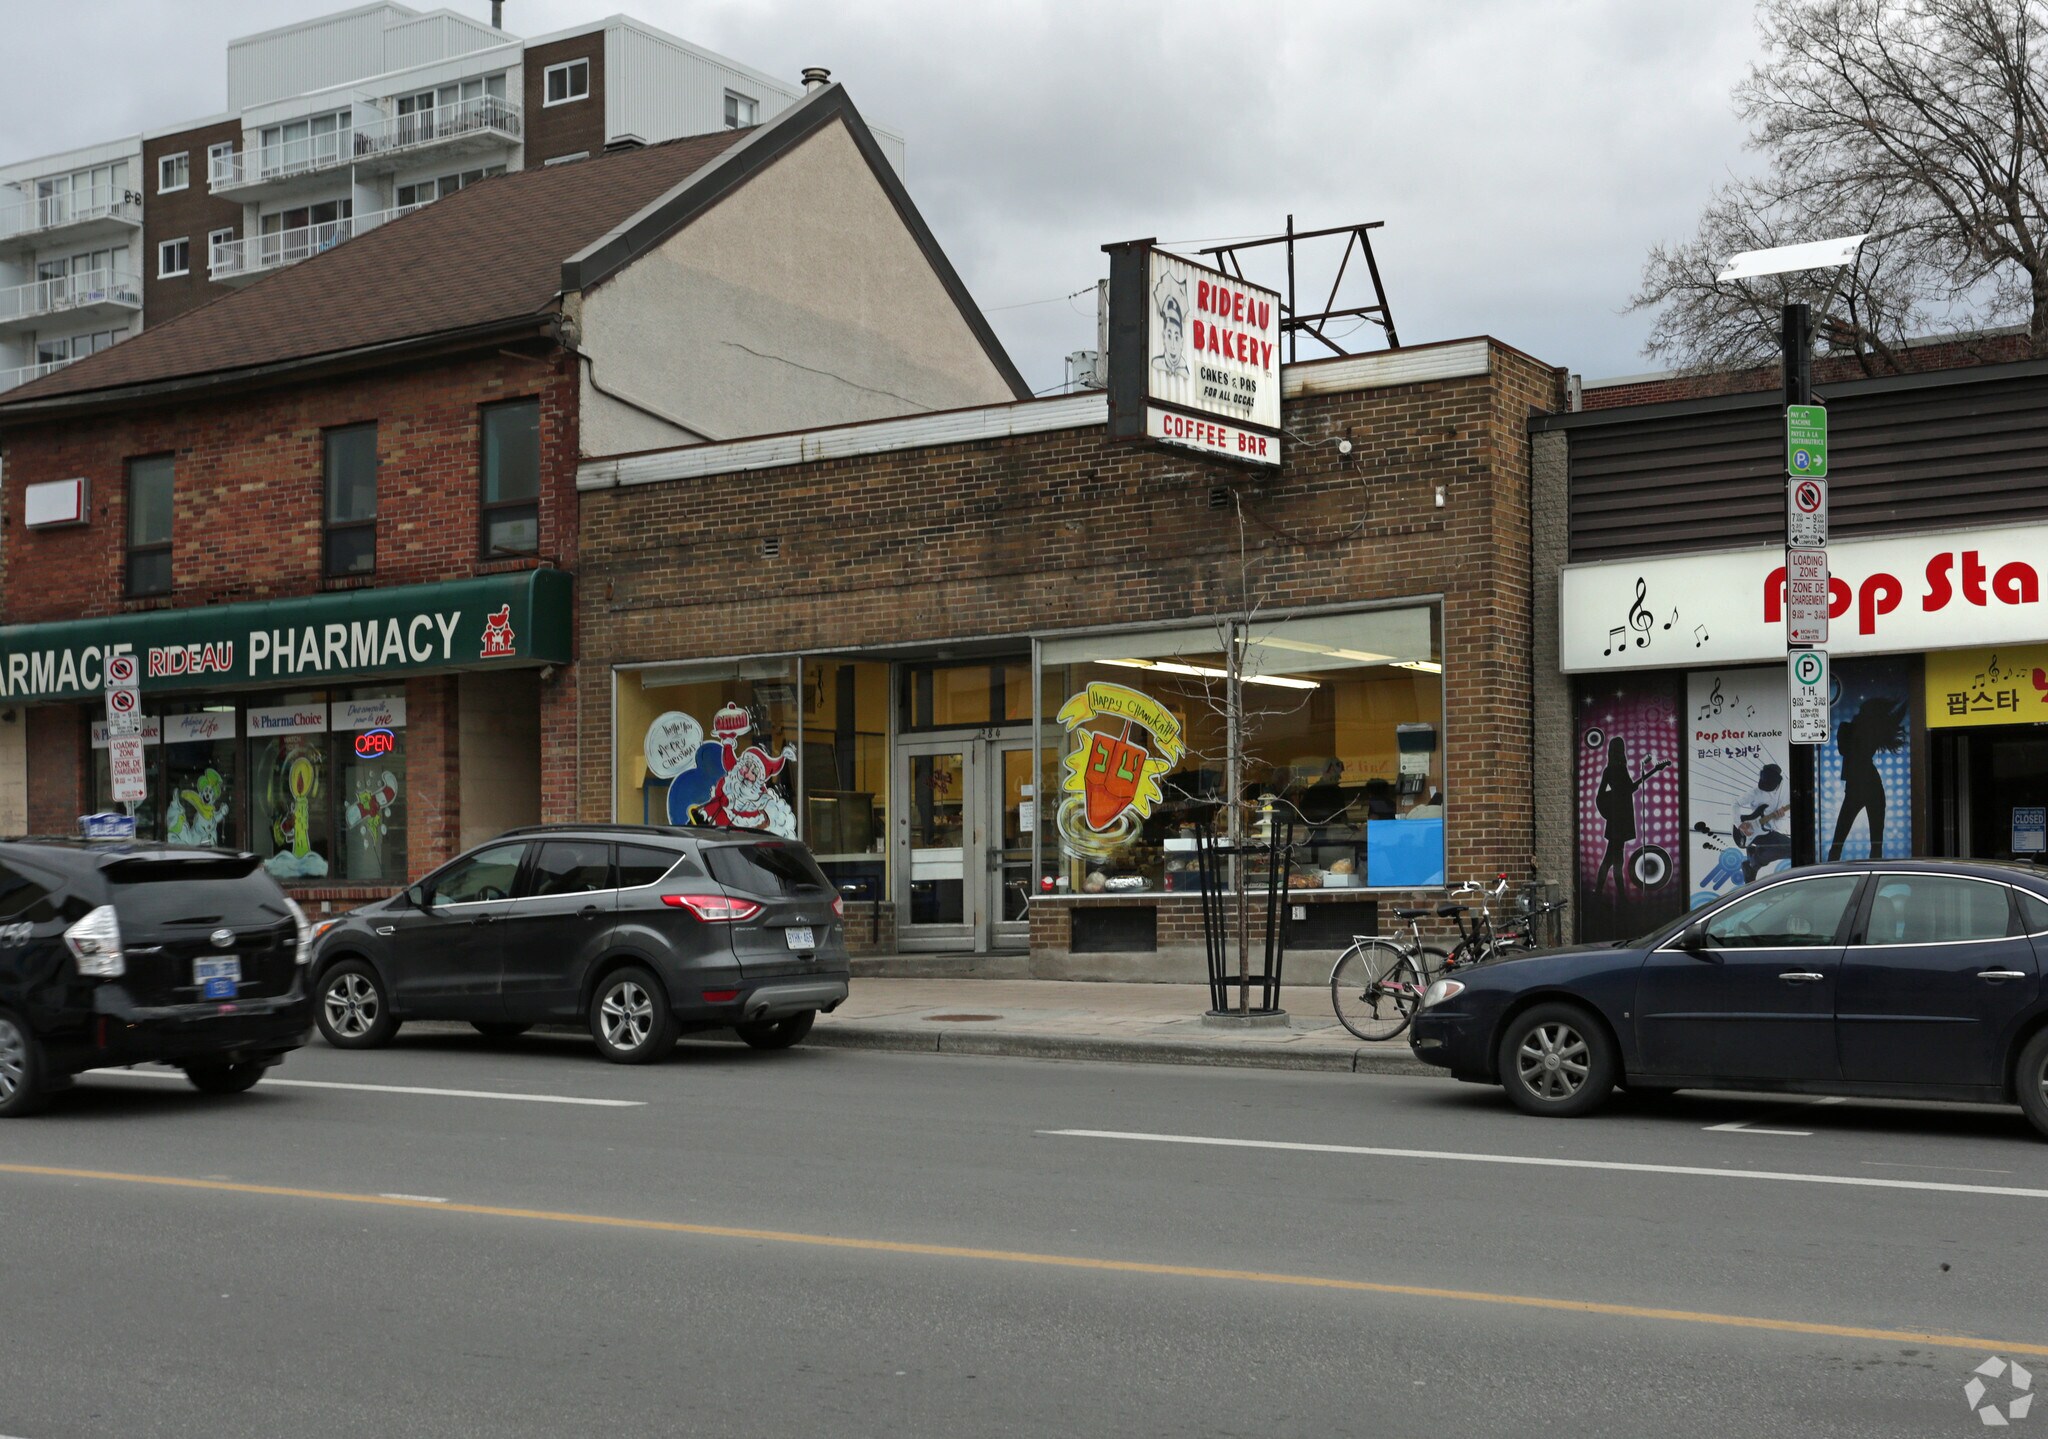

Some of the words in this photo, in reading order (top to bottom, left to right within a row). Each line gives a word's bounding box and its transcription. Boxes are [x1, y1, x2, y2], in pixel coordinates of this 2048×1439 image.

[1198, 280, 1270, 330] RIDEAU
[1193, 319, 1273, 370] BAKERY
[1200, 366, 1229, 386] CAKES
[1240, 377, 1257, 393] PAS
[1203, 386, 1217, 398] FOR
[1219, 390, 1231, 402] ALL
[1163, 414, 1227, 448] COFFEE
[1238, 432, 1267, 457] BAR
[1793, 555, 1823, 566] LOADING
[1800, 567, 1818, 577] ZONE
[1793, 582, 1812, 593] ZONE
[1815, 583, 1824, 593] DE
[1922, 550, 2040, 612] Sta
[1792, 595, 1825, 606] CHARGEMENT
[0, 643, 133, 697] RMAC
[148, 641, 233, 677] RIDEAU
[249, 611, 462, 676] PHARMACY
[1092, 691, 1122, 711] HAPPY
[1946, 688, 2020, 716] 팝스타
[200, 717, 219, 737] Life
[261, 712, 322, 729] PharmaChoice
[355, 734, 393, 752] OPEN
[1696, 731, 1719, 743] Pop
[1721, 729, 1745, 740] Star
[1747, 730, 1782, 738] Karaoke
[113, 741, 139, 750] LOADING
[1697, 748, 1721, 759] 팝스타
[1725, 745, 1761, 759] 노래방
[114, 760, 130, 769] ZONE
[133, 759, 140, 767] DE
[662, 744, 696, 769] CHRISTMAS
[114, 767, 142, 776] CHARGEMENT
[2015, 814, 2044, 824] CLOSED
